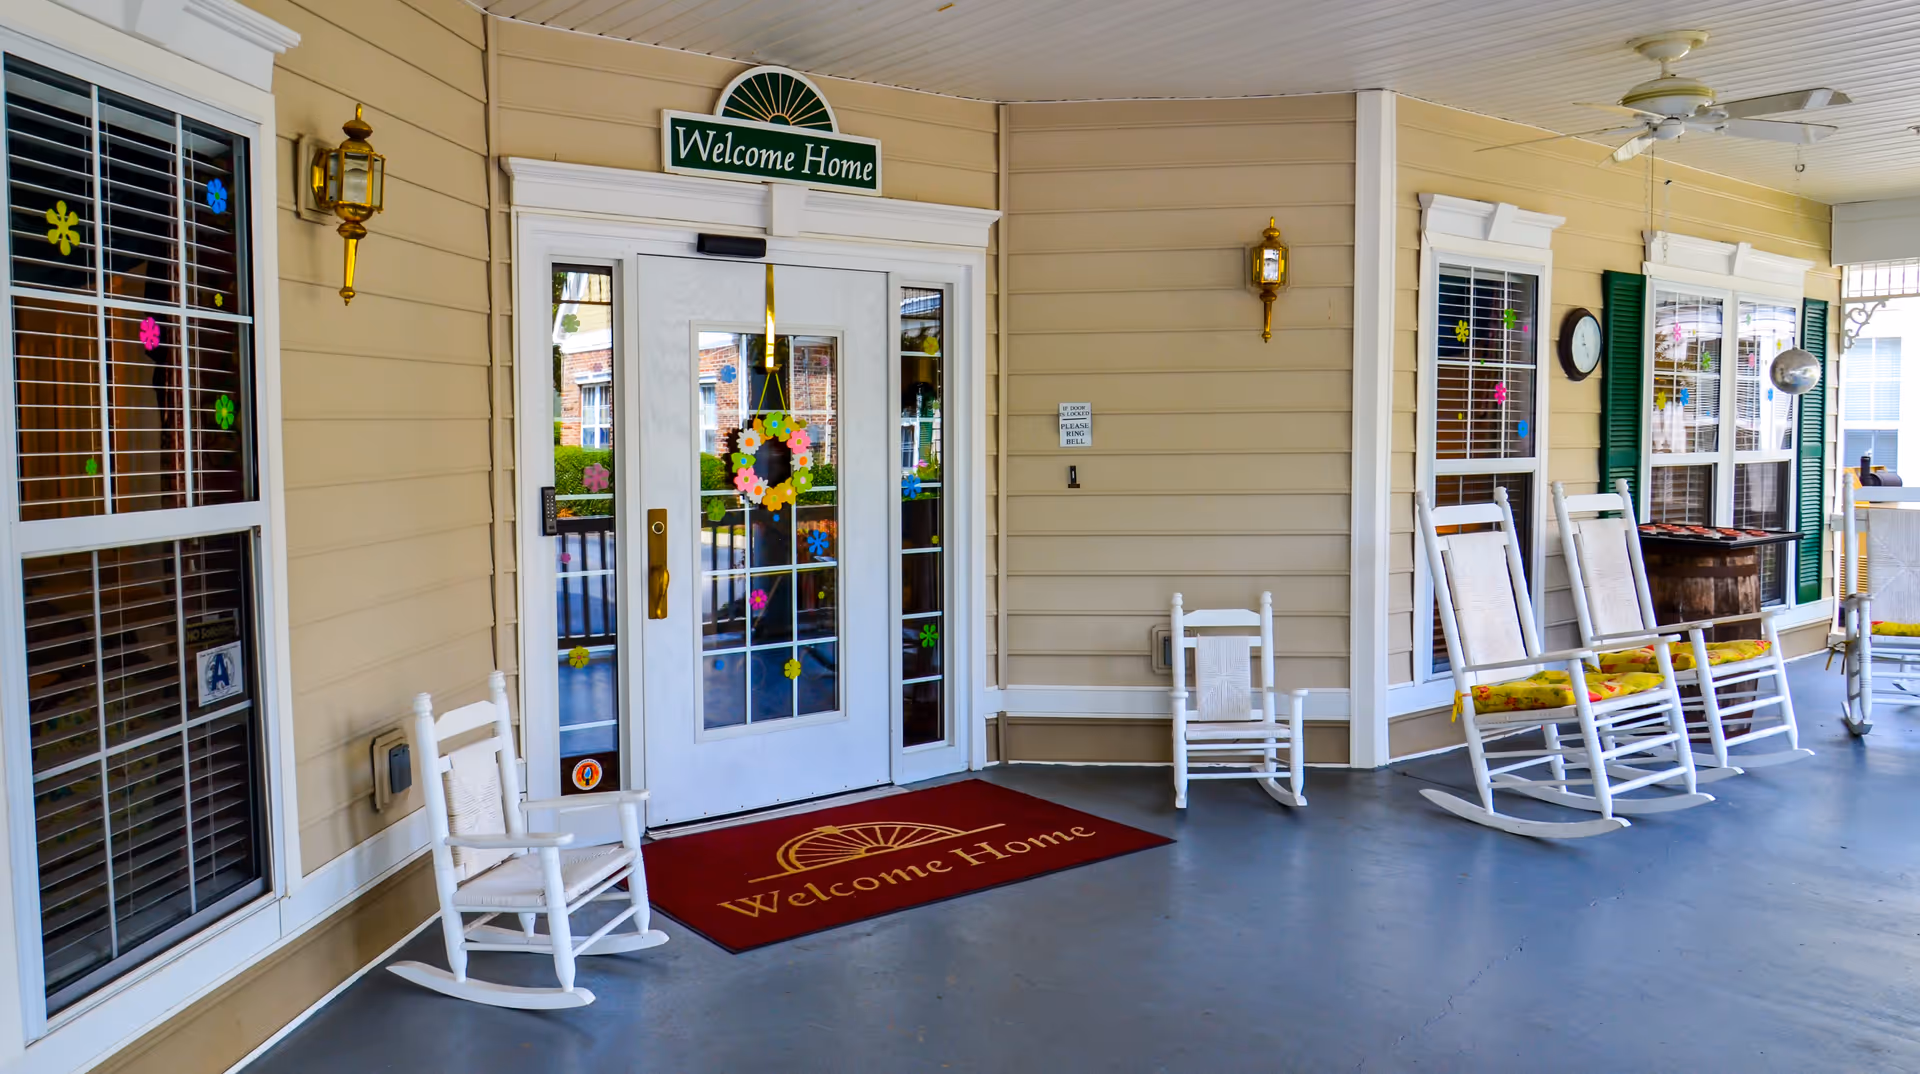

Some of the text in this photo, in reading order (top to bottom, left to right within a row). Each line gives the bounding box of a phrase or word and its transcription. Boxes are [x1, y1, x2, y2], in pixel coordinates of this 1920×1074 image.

[675, 126, 873, 181] Welcome Home
[211, 653, 230, 691] A
[717, 826, 1096, 918] Welcome Home
